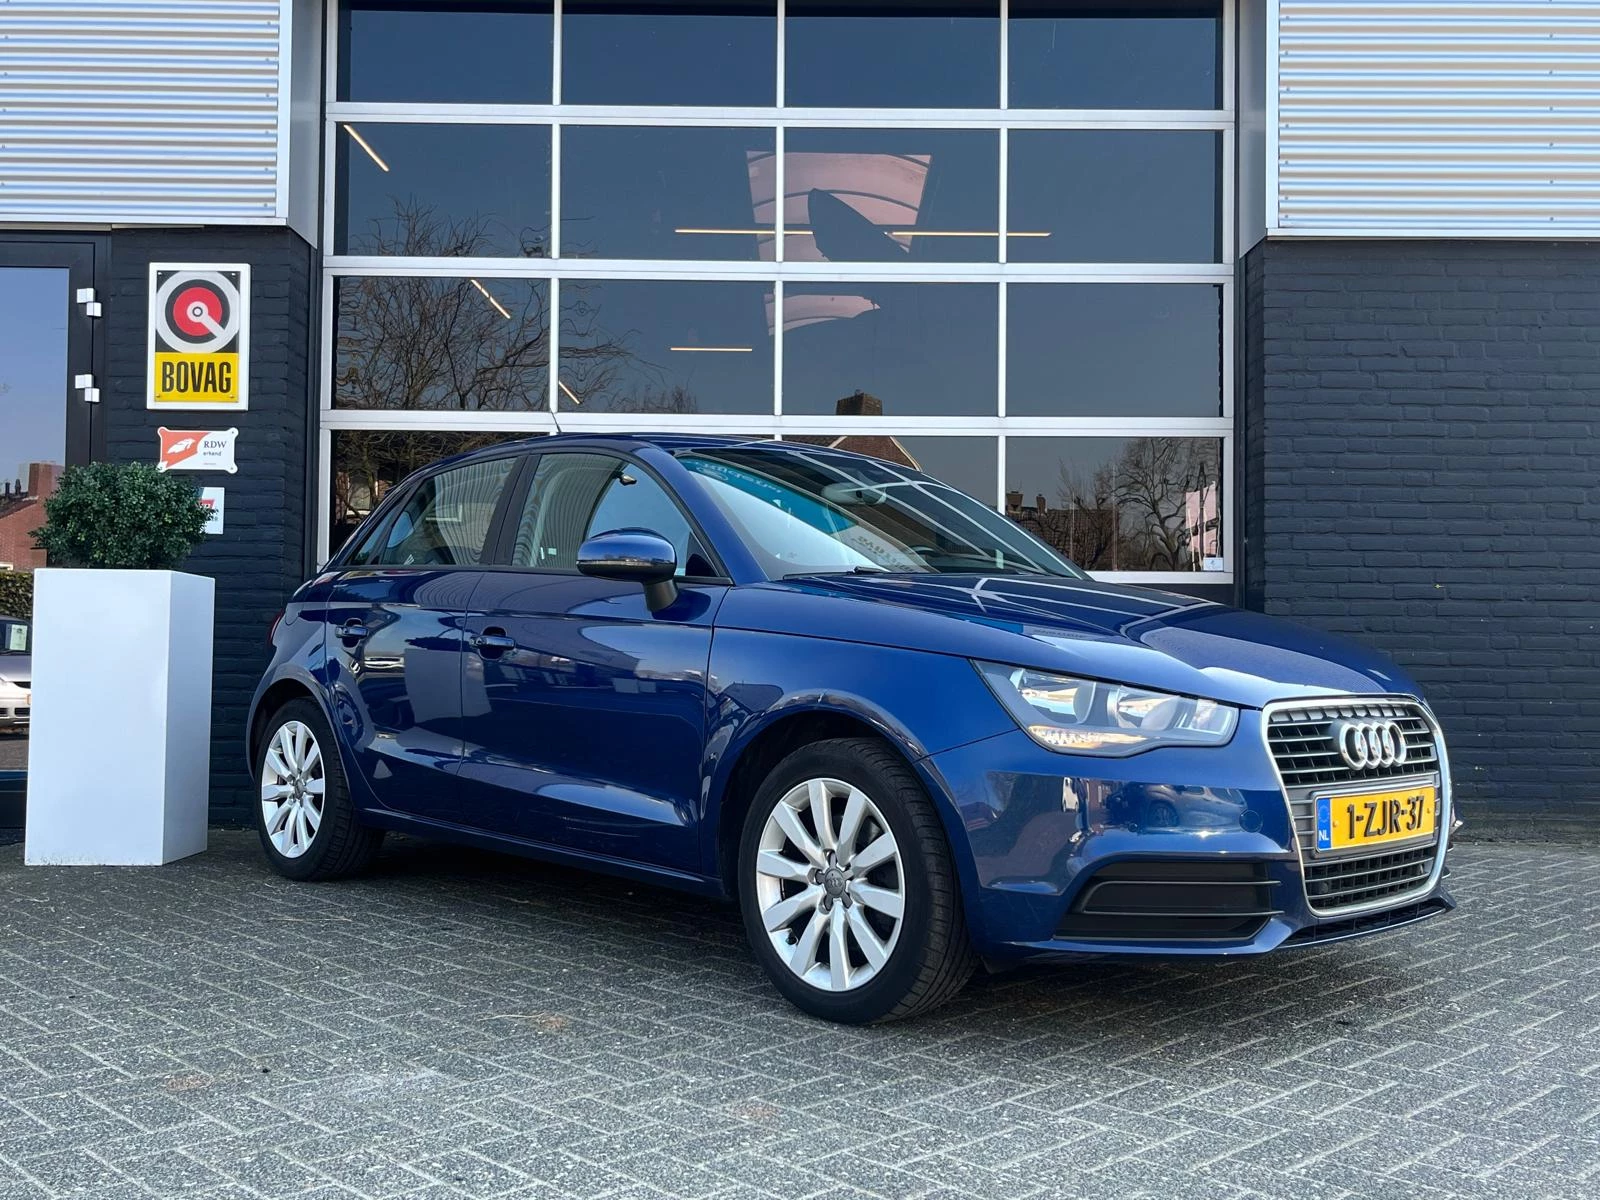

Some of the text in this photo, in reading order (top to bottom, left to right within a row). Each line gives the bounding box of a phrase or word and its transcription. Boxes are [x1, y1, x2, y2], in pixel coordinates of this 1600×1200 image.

[162, 361, 231, 393] BOVAG
[203, 440, 227, 449] RDW
[1347, 796, 1425, 840] 1-ZJR-37
[1318, 829, 1329, 841] NL
